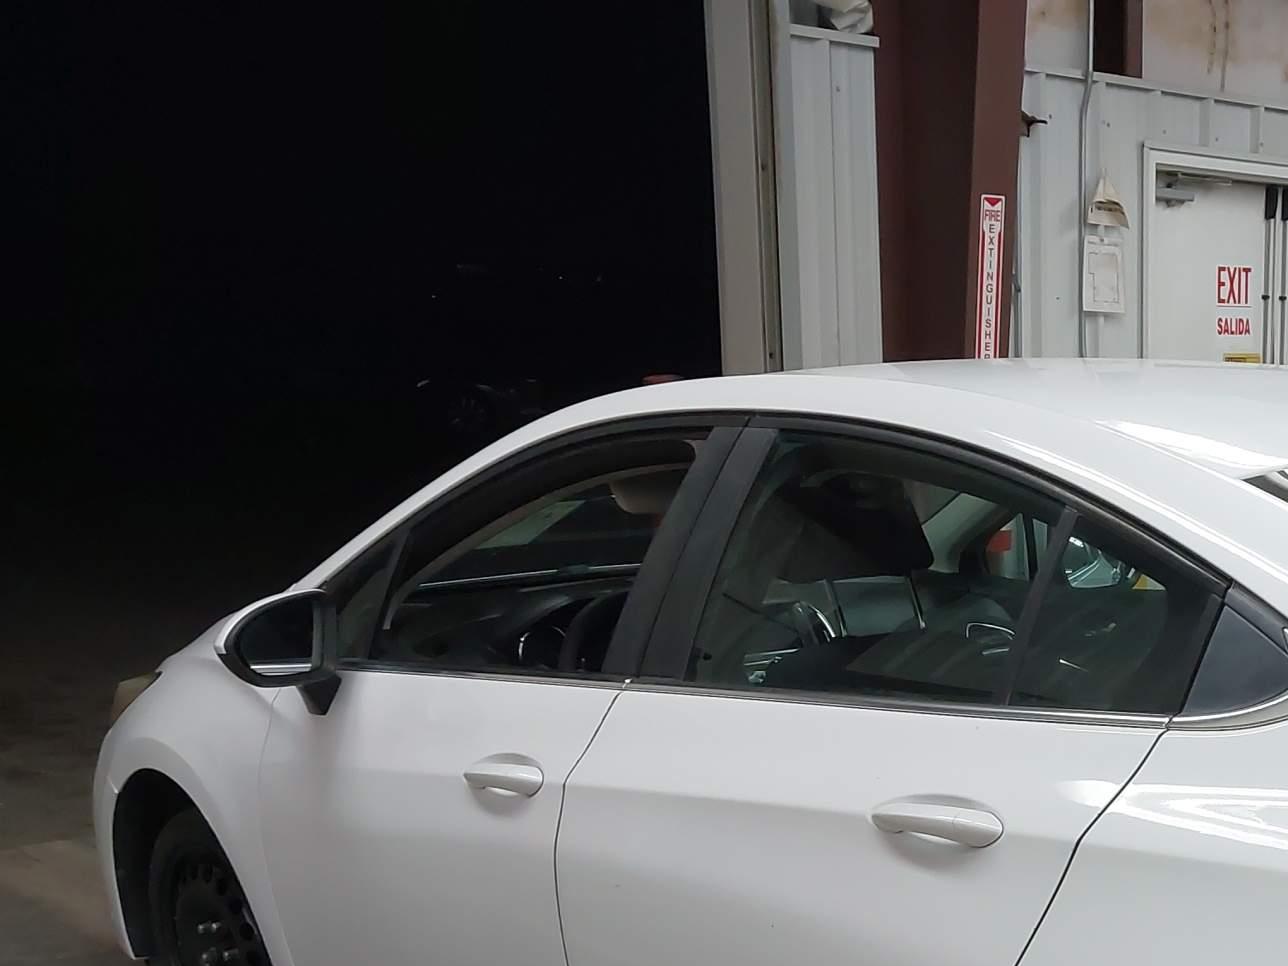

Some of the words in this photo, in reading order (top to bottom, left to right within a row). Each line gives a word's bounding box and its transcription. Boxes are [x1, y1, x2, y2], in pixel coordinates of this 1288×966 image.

[984, 209, 1001, 222] FIRE
[1217, 266, 1252, 305] EXIT
[1216, 317, 1251, 336] SALIDA
